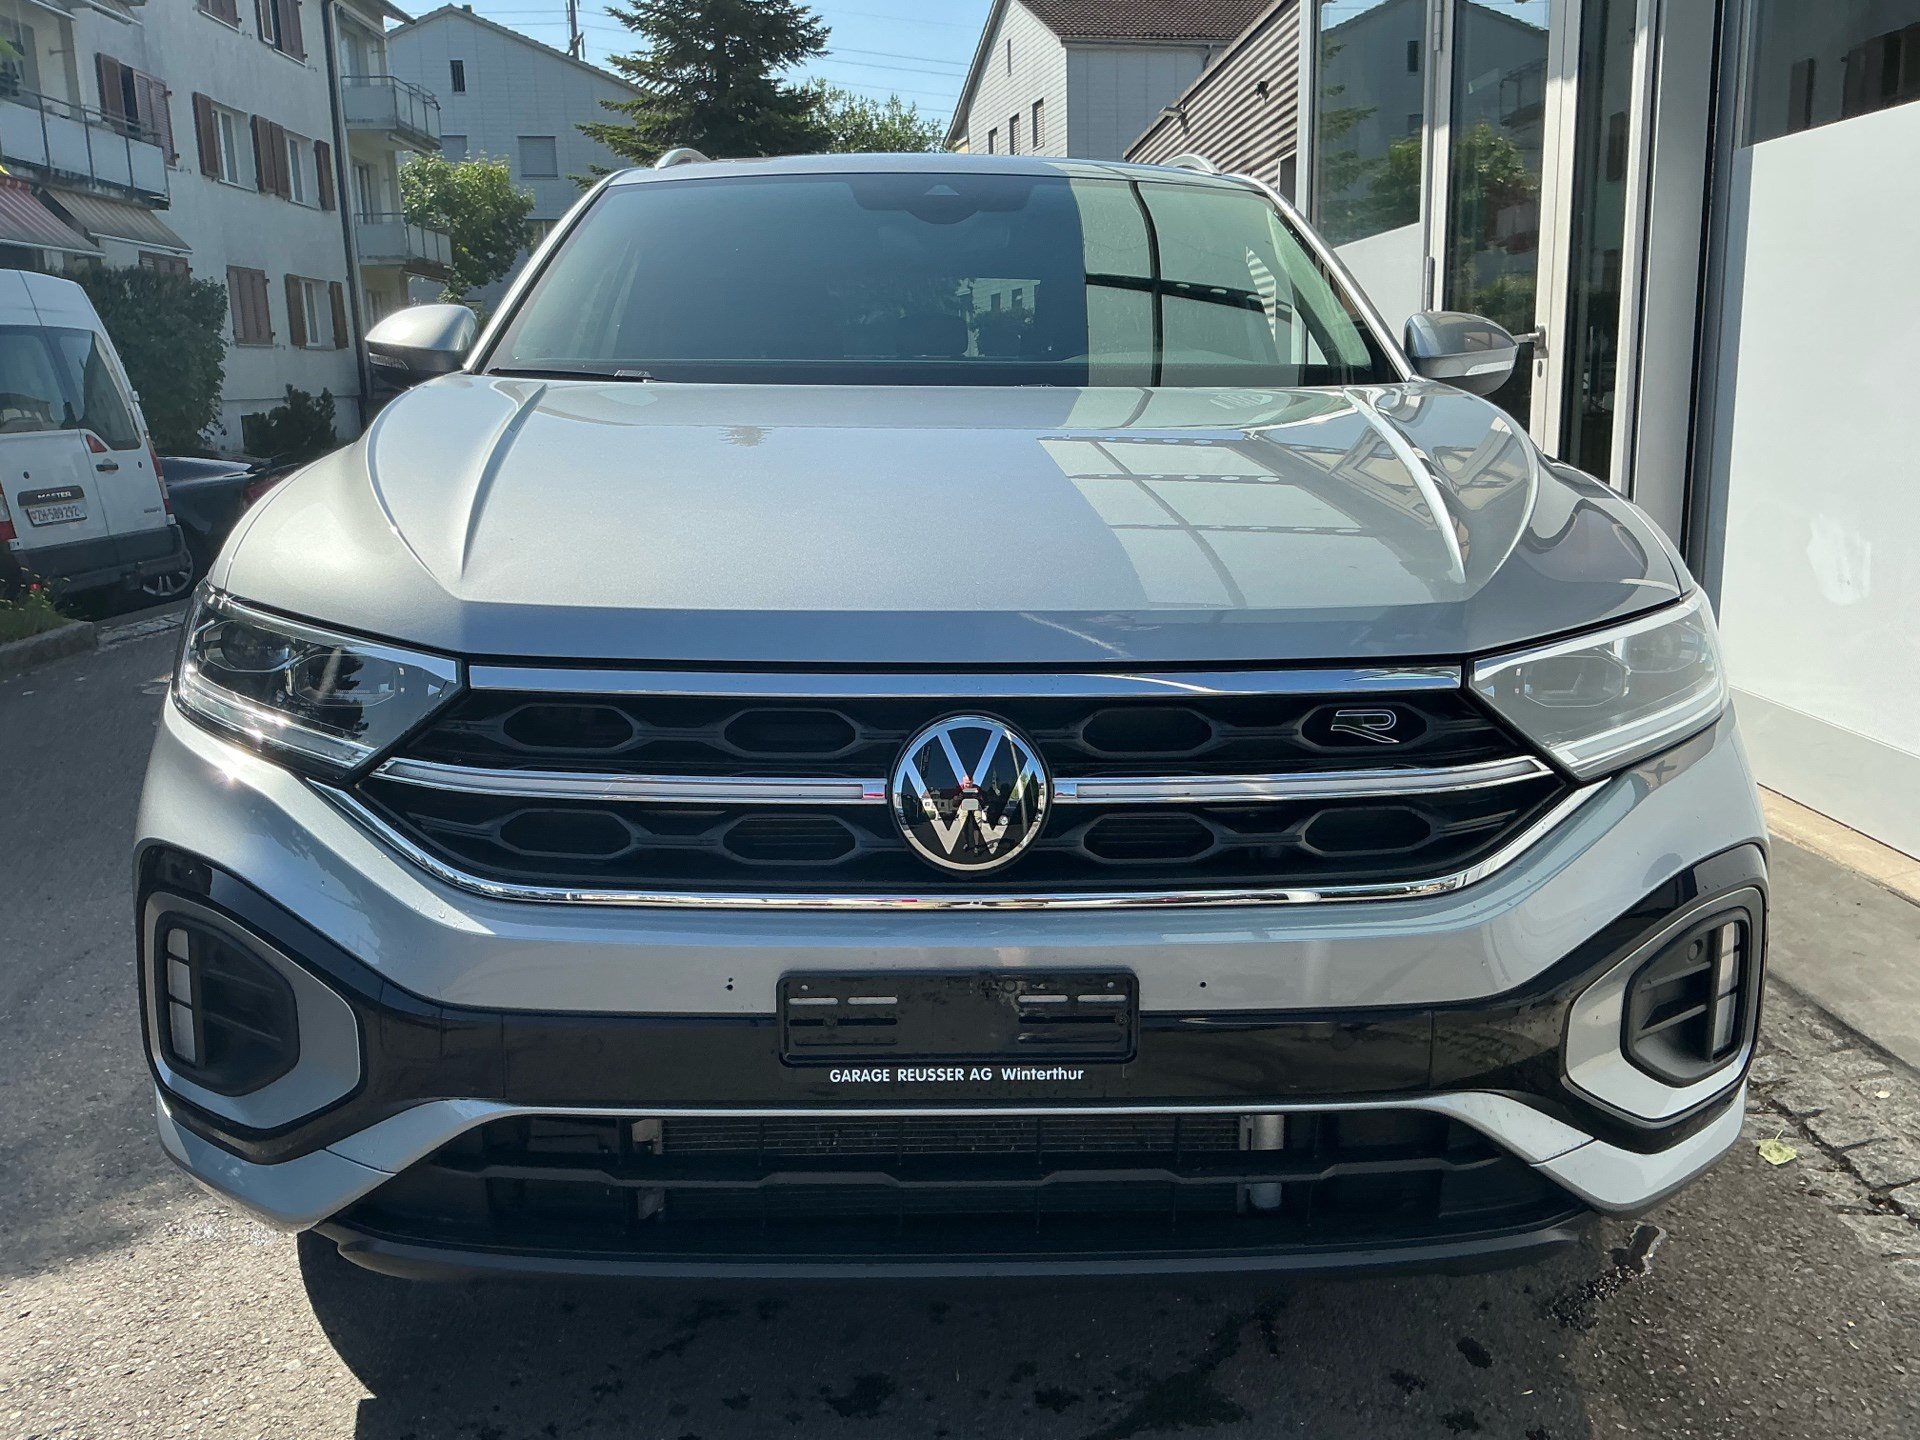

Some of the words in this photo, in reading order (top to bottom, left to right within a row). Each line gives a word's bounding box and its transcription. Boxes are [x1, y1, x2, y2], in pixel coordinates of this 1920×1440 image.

[829, 1068, 890, 1083] GARAGE
[897, 1068, 965, 1082] REUSSER
[969, 1067, 993, 1081] AG
[1001, 1067, 1084, 1081] Winterthur
